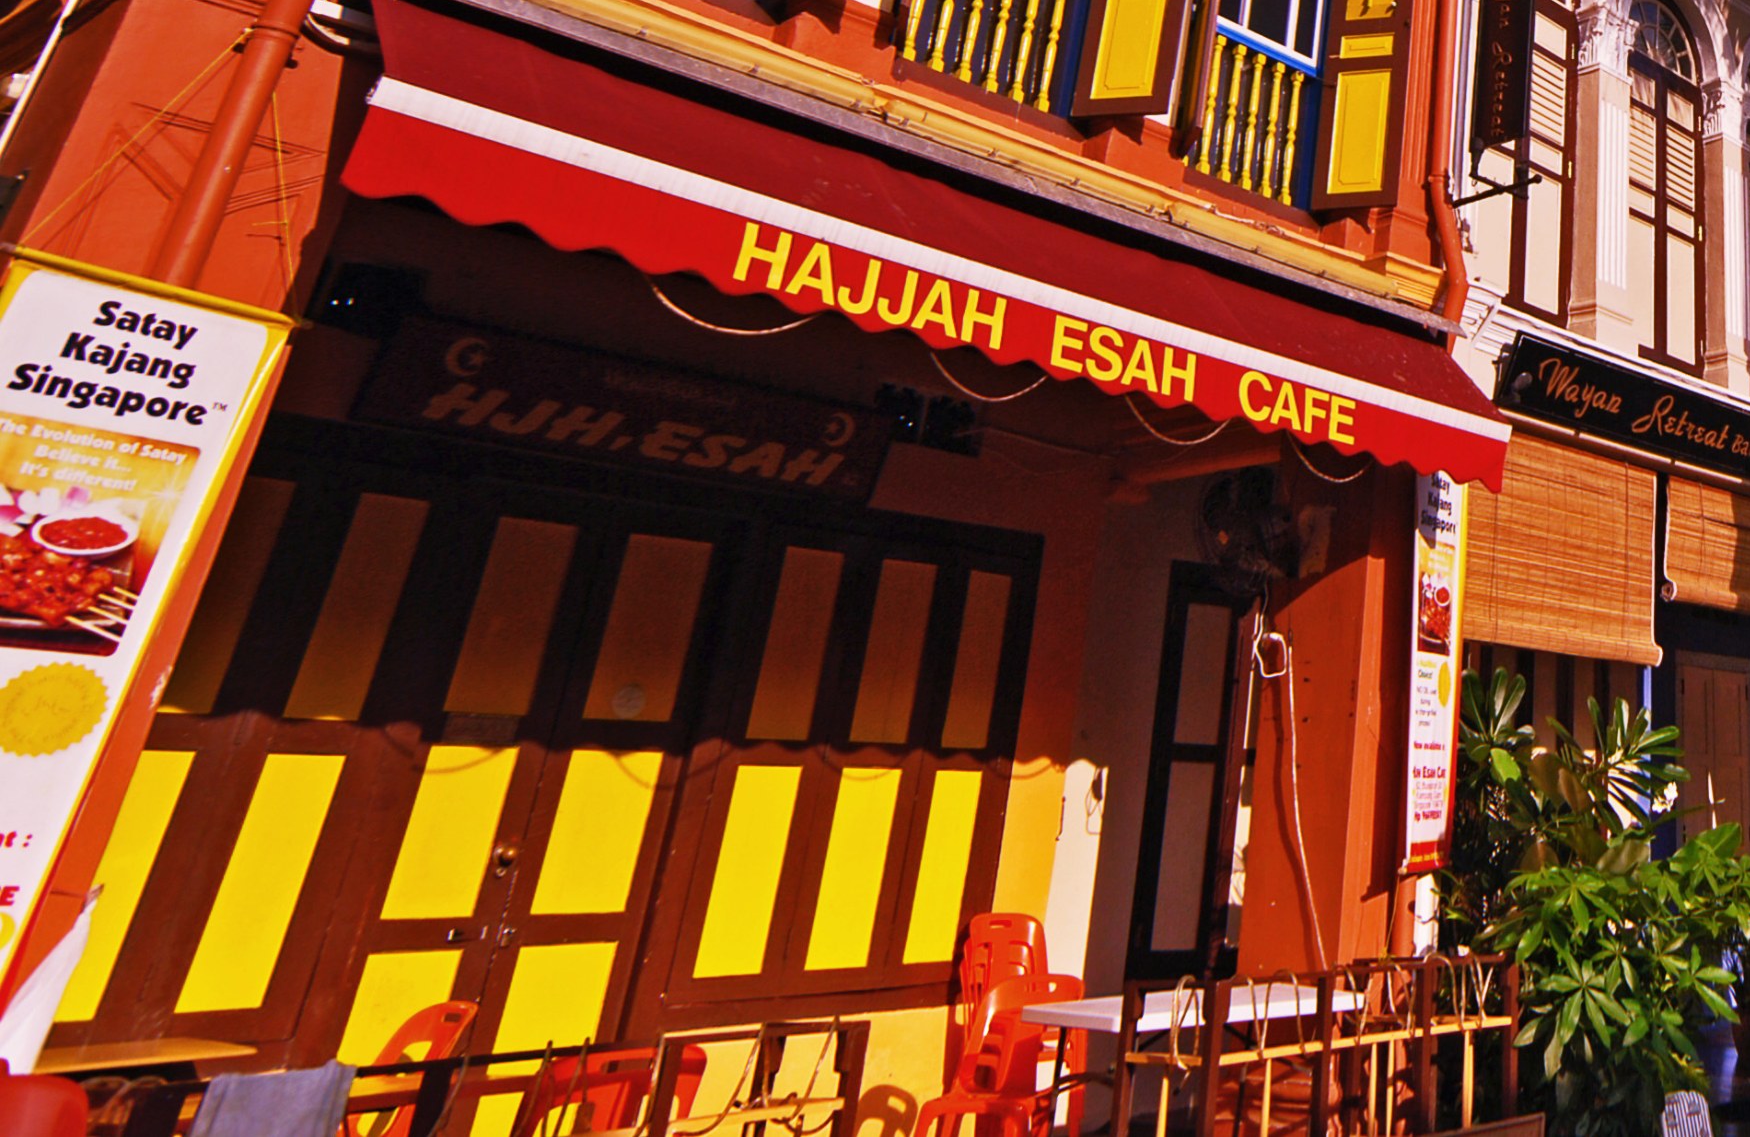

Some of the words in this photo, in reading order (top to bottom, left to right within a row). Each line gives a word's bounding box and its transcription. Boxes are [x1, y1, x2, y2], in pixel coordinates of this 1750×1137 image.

[93, 300, 198, 350] Satay
[732, 222, 1008, 350] HAJJAH
[1050, 316, 1197, 402] ESAH
[1238, 371, 1357, 445] CAFE
[61, 332, 197, 389] Kajang
[7, 363, 208, 426] Singapore
[1538, 358, 1623, 418] Wayan
[1631, 395, 1730, 450] Retreat
[31, 424, 115, 452] Evolution
[118, 440, 141, 456] of
[139, 445, 188, 466] Satay
[34, 445, 101, 467] Believe
[640, 420, 848, 486] ESAH
[19, 462, 49, 478] It's
[53, 467, 137, 492] different!
